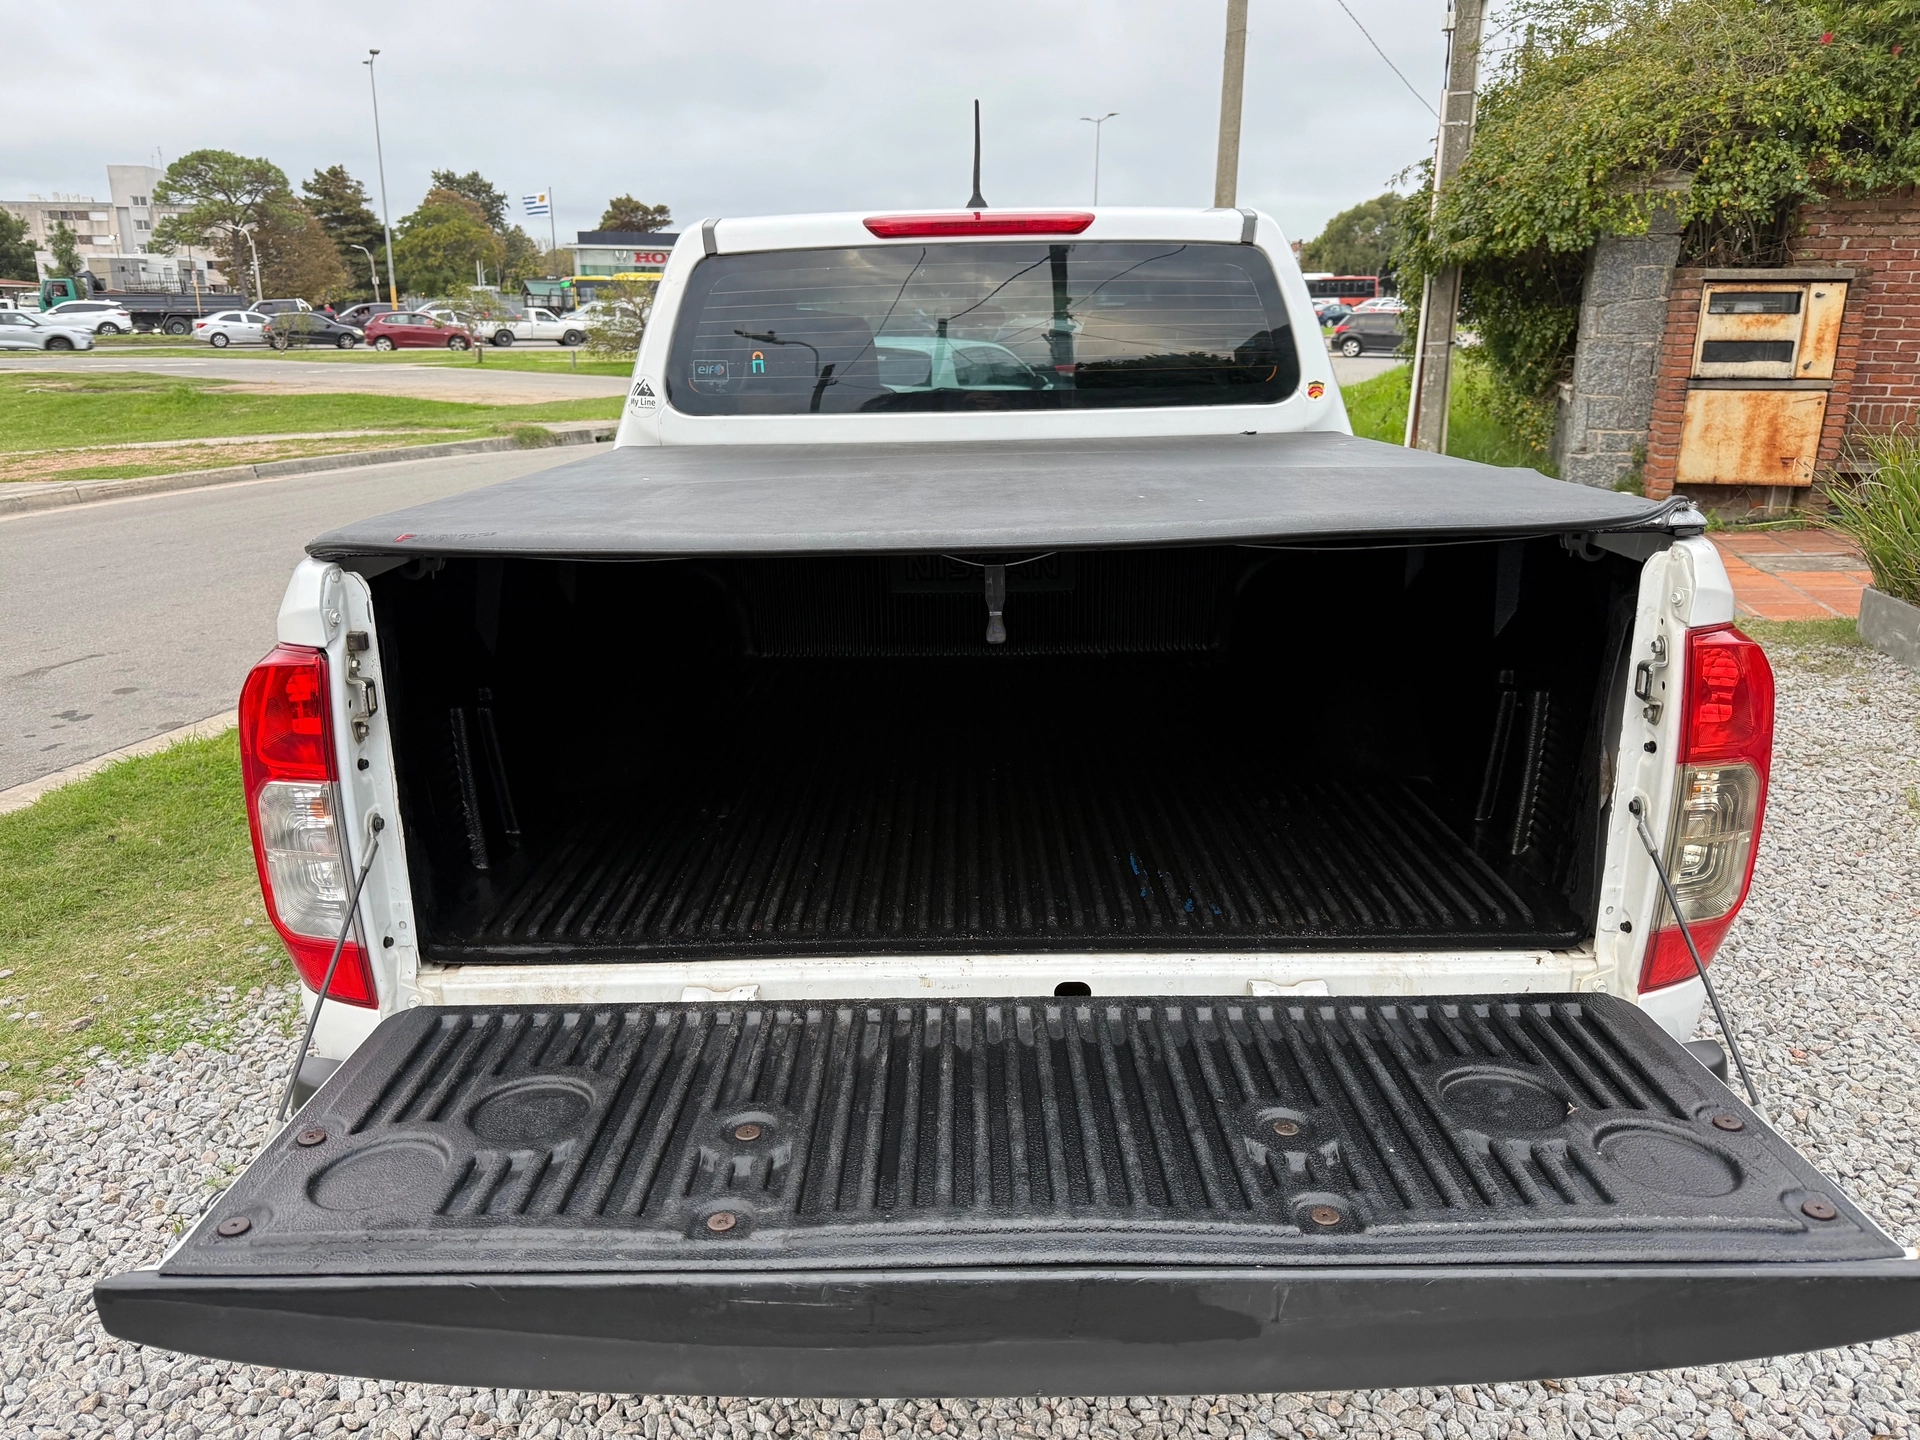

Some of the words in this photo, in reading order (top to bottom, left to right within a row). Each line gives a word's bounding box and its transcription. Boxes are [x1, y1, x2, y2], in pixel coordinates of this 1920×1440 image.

[634, 251, 673, 264] HO
[697, 365, 715, 375] elf
[640, 397, 656, 407] Line
